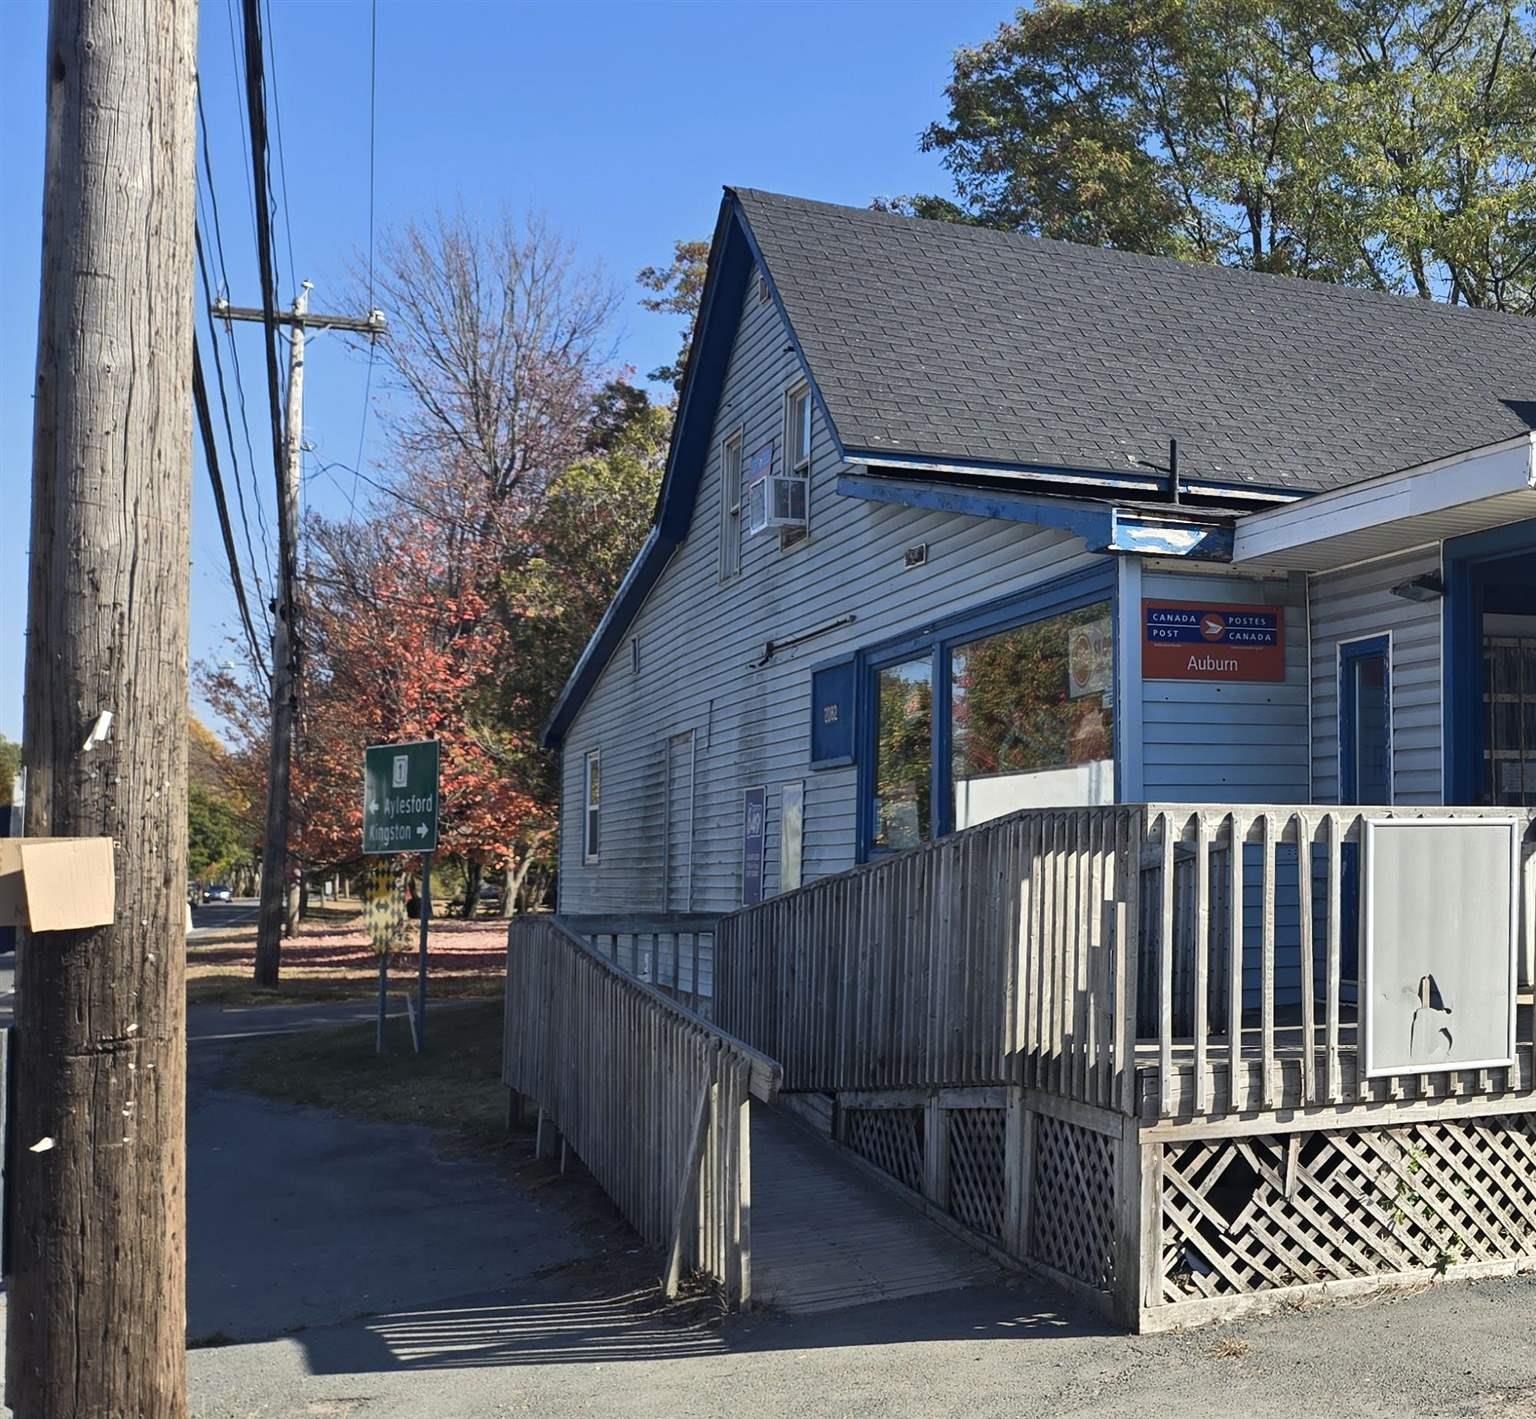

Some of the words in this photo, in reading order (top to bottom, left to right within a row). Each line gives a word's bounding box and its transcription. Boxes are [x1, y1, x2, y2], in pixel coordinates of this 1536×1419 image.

[1152, 613, 1196, 623] CANADA
[1228, 617, 1267, 626] POSTES
[1152, 629, 1179, 638] POST
[1228, 632, 1272, 641] CANADA
[1187, 655, 1238, 671] Auburn
[384, 794, 433, 819] Aylesford
[369, 823, 411, 846] Kingston
